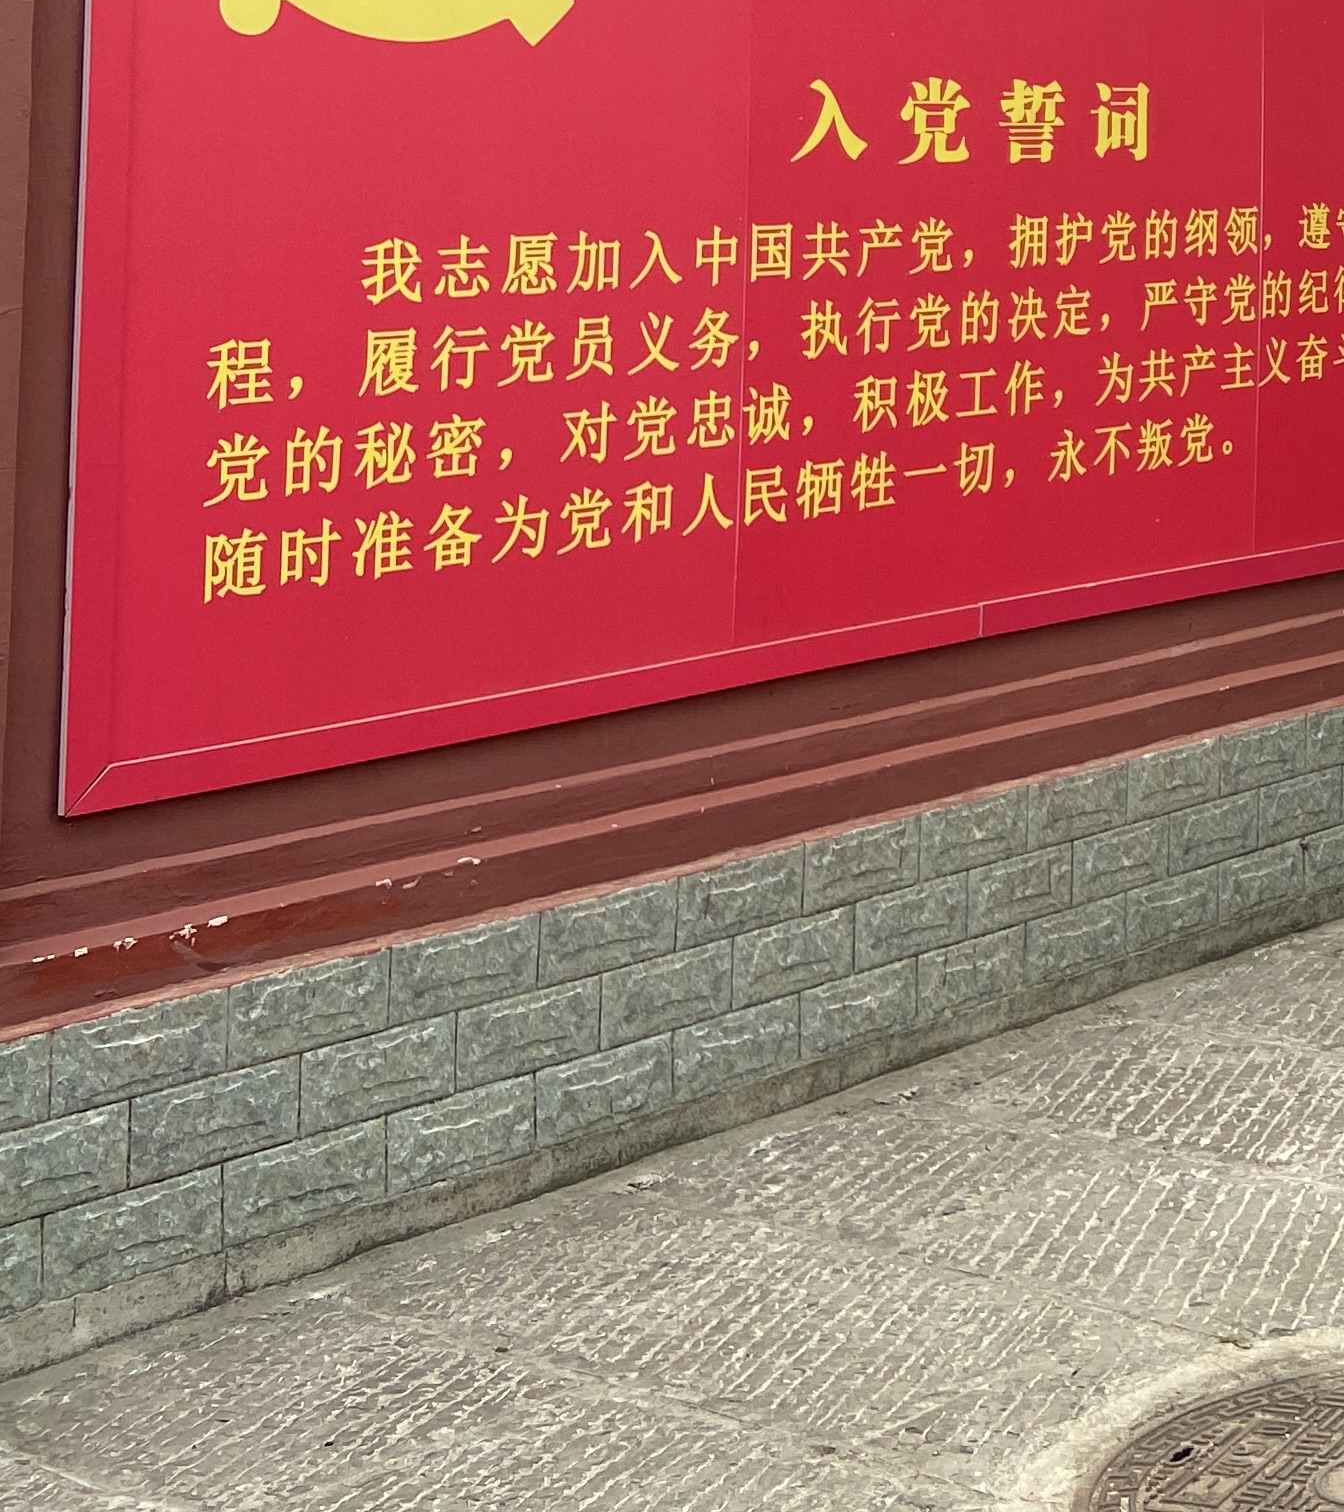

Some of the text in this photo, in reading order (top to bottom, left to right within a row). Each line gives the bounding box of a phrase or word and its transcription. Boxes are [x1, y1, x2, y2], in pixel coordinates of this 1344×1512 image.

[792, 77, 1150, 165] 入党誓词
[203, 414, 1238, 604] 随时准备为党和人民牺牲一切，永不叛党。
